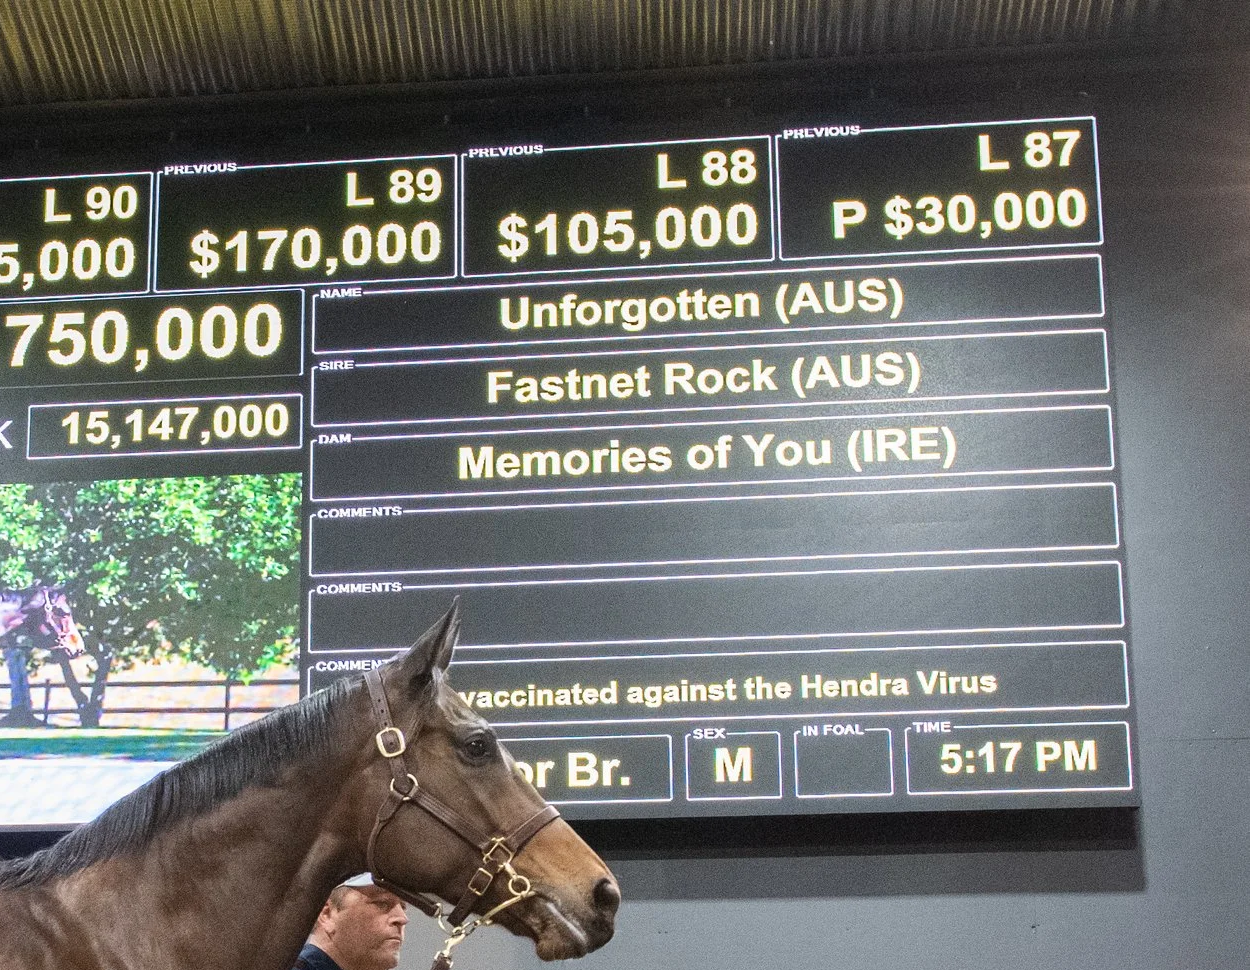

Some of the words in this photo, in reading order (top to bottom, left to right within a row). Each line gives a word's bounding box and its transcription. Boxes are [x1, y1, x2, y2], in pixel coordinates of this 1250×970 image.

[783, 124, 861, 140] PREVIOUS
[163, 161, 238, 175] PREVIOUS
[468, 144, 544, 159] PREVIOUS
[657, 154, 687, 189] L
[702, 149, 757, 186] 88
[978, 134, 1010, 171] L
[1024, 131, 1080, 168] 87
[44, 188, 72, 223] L
[86, 185, 138, 220] 90
[347, 172, 374, 207] L
[389, 168, 442, 204] 89
[498, 202, 758, 263] $105,000
[833, 200, 867, 239] P
[884, 188, 1086, 240] $30,000
[189, 221, 442, 278] $170,000
[319, 287, 363, 299] NAME
[499, 288, 761, 332] Unforgotten
[774, 277, 905, 325] (AUS)
[318, 359, 355, 372] SIRE
[487, 368, 652, 404] Fastnet
[664, 358, 779, 396] Rock
[791, 351, 921, 399] (AUS)
[60, 402, 290, 447] 15,147,000
[318, 432, 352, 444] DAM
[458, 439, 673, 479] Memories
[686, 434, 734, 471] of
[741, 433, 833, 467] You
[846, 426, 958, 472] (IRE)
[317, 505, 403, 518] COMMENTS
[316, 581, 402, 595] COMMENTS
[315, 658, 391, 672] COMMEN
[457, 680, 618, 709] vaccinated
[626, 677, 738, 709] against
[743, 675, 793, 701] the
[800, 672, 910, 699] Hendra
[915, 669, 998, 695] Virus
[693, 728, 725, 739] SEX
[802, 725, 819, 736] IN
[823, 723, 864, 736] FOAL
[913, 721, 951, 733] TIME
[567, 751, 631, 788] Br.
[715, 746, 752, 783] M
[940, 741, 1022, 774] 5:17
[1035, 739, 1097, 772] PM
